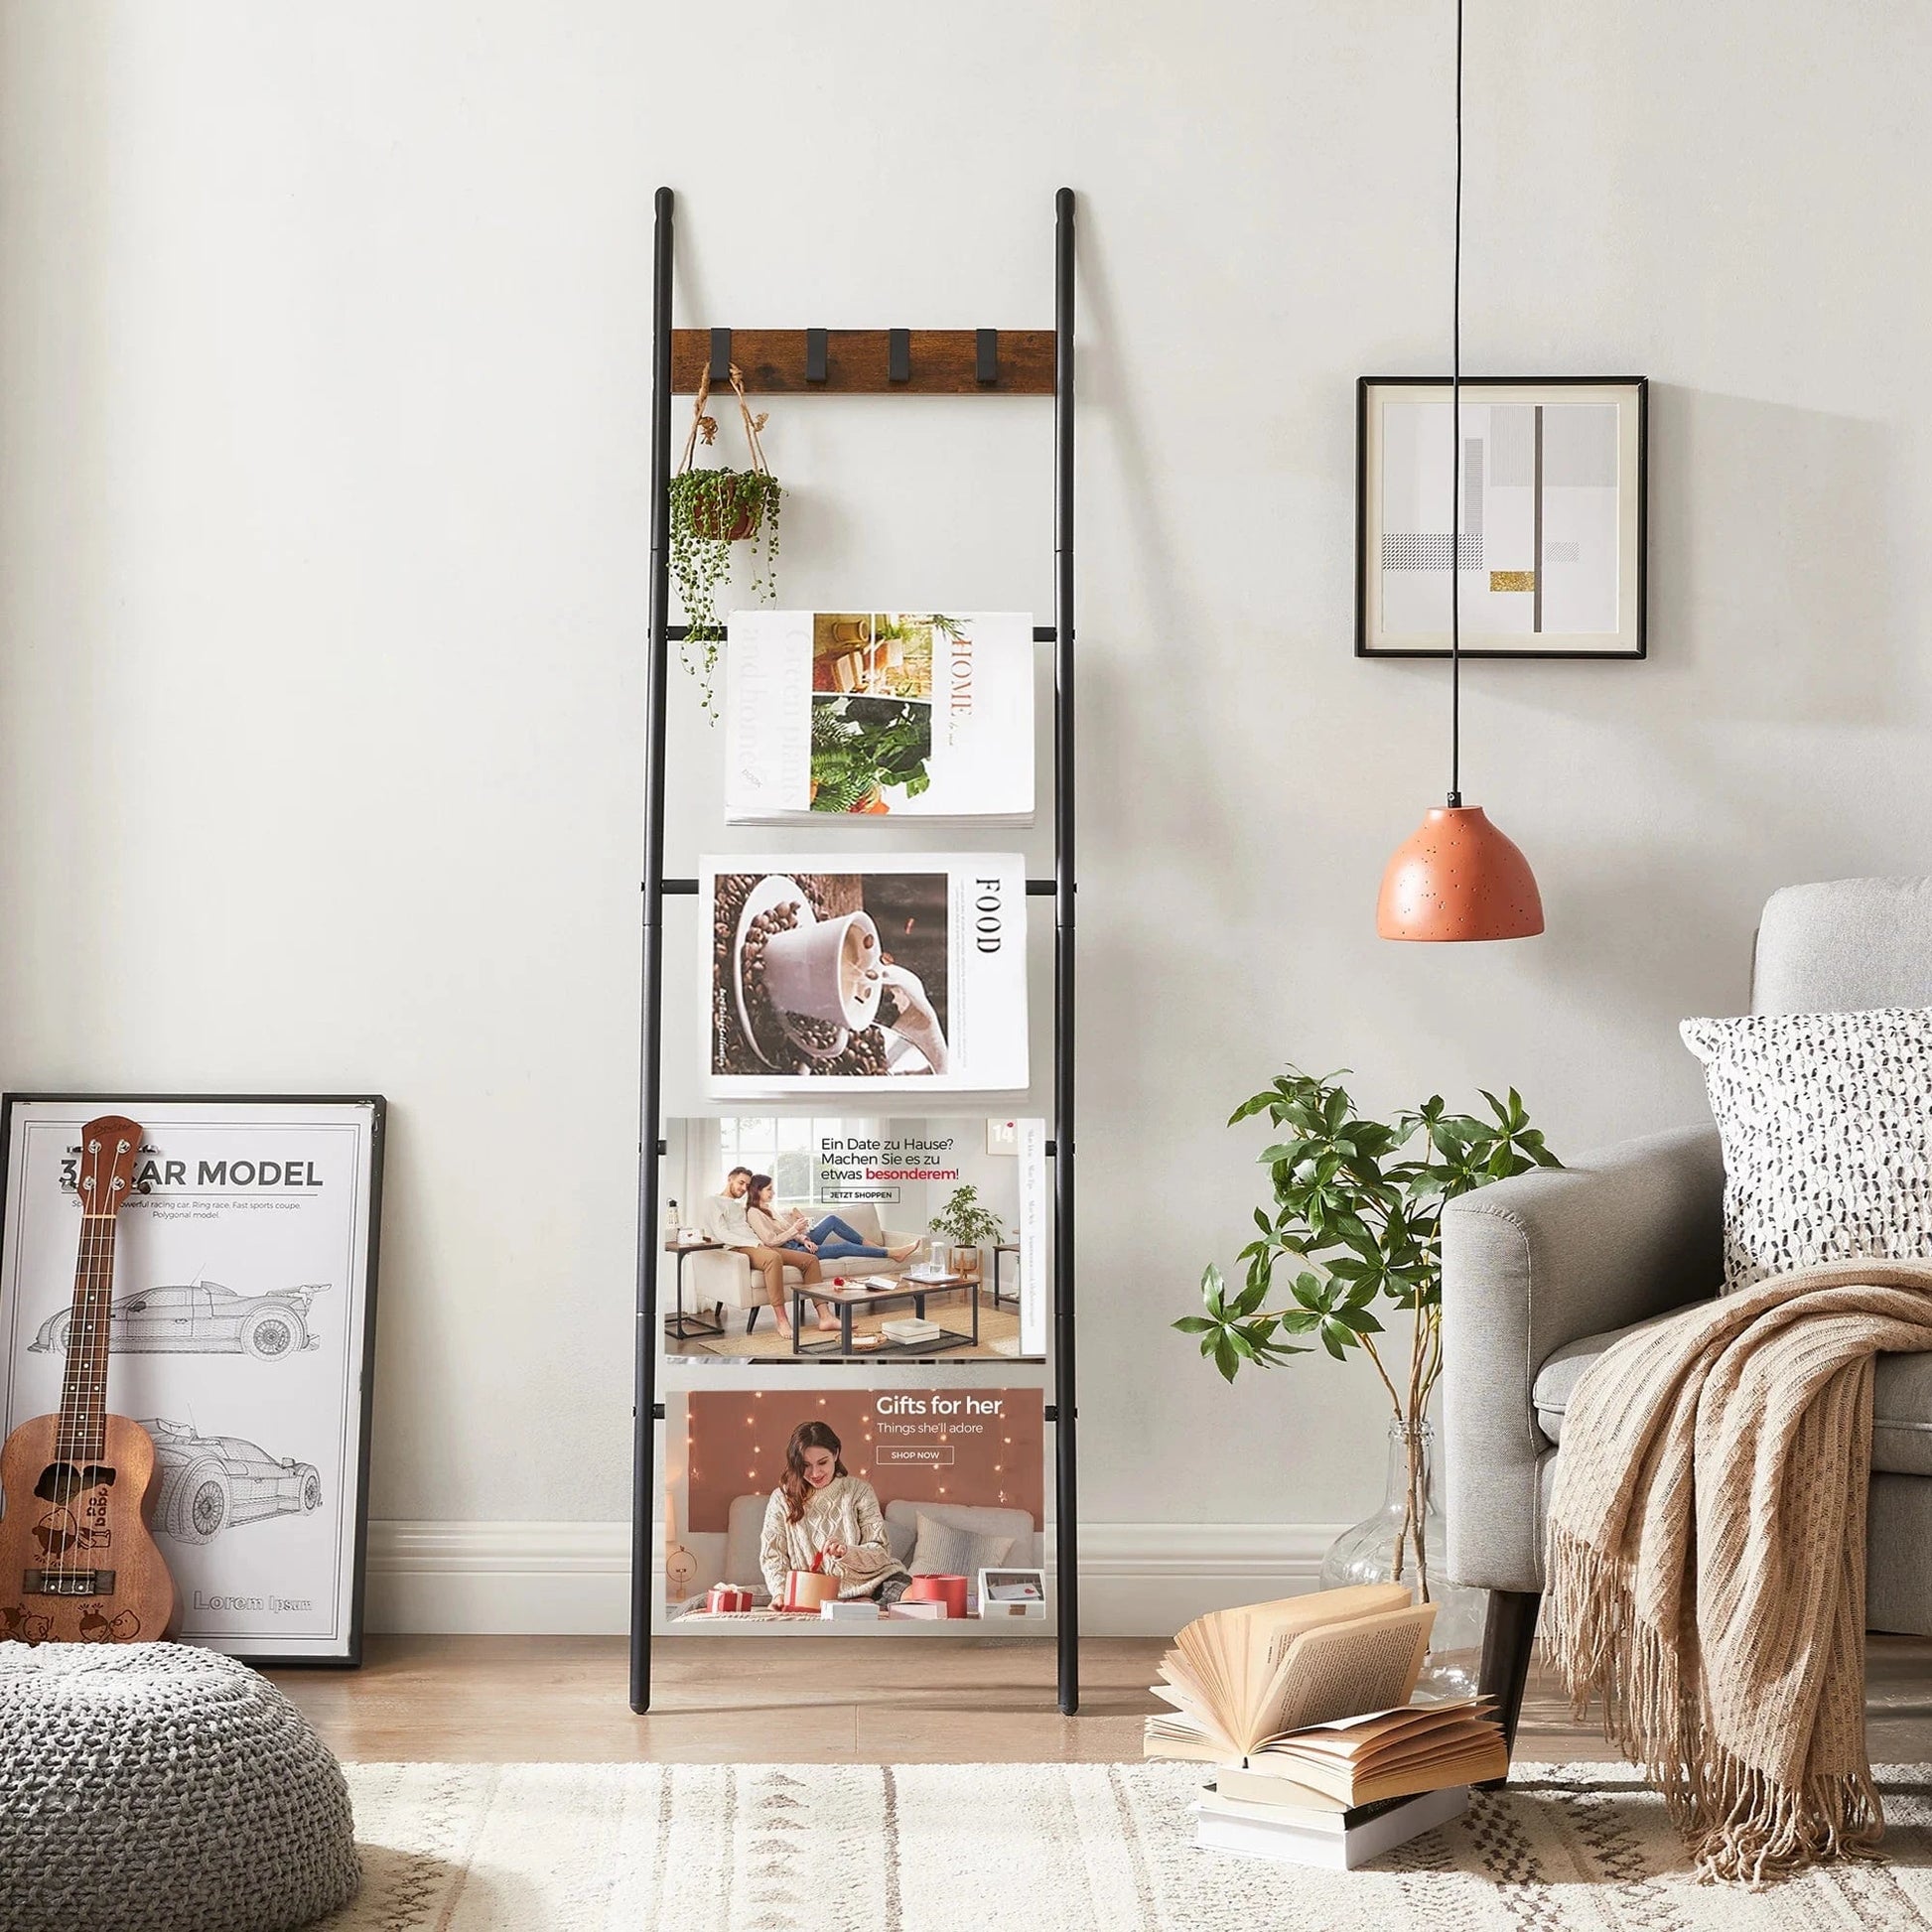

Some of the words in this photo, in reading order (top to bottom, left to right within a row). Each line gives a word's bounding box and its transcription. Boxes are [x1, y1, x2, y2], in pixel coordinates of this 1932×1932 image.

[950, 639, 973, 717] HOME
[976, 879, 1001, 954] FOOD
[821, 1138, 844, 1151] Ein
[847, 1138, 881, 1151] Date
[883, 1140, 900, 1151] zu
[903, 1138, 954, 1151] Hause?
[821, 1153, 879, 1166] Machen
[881, 1153, 902, 1166] Sie
[904, 1155, 920, 1166] es
[923, 1155, 940, 1166] zu
[131, 1160, 186, 1185] AR
[198, 1160, 324, 1186] MODEL
[820, 1169, 863, 1180] etwas
[866, 1168, 959, 1180] besonderem!
[192, 1201, 210, 1210] Ring
[249, 1201, 274, 1211] sports
[152, 1210, 192, 1219] Polygonal
[876, 1395, 926, 1415] Gifts
[931, 1395, 962, 1415] for
[966, 1395, 1003, 1415] her
[877, 1422, 916, 1436] Things
[917, 1422, 947, 1434] she'll
[948, 1422, 984, 1434] adore
[193, 1589, 264, 1611] Lorem
[269, 1594, 313, 1614] Ipsum
